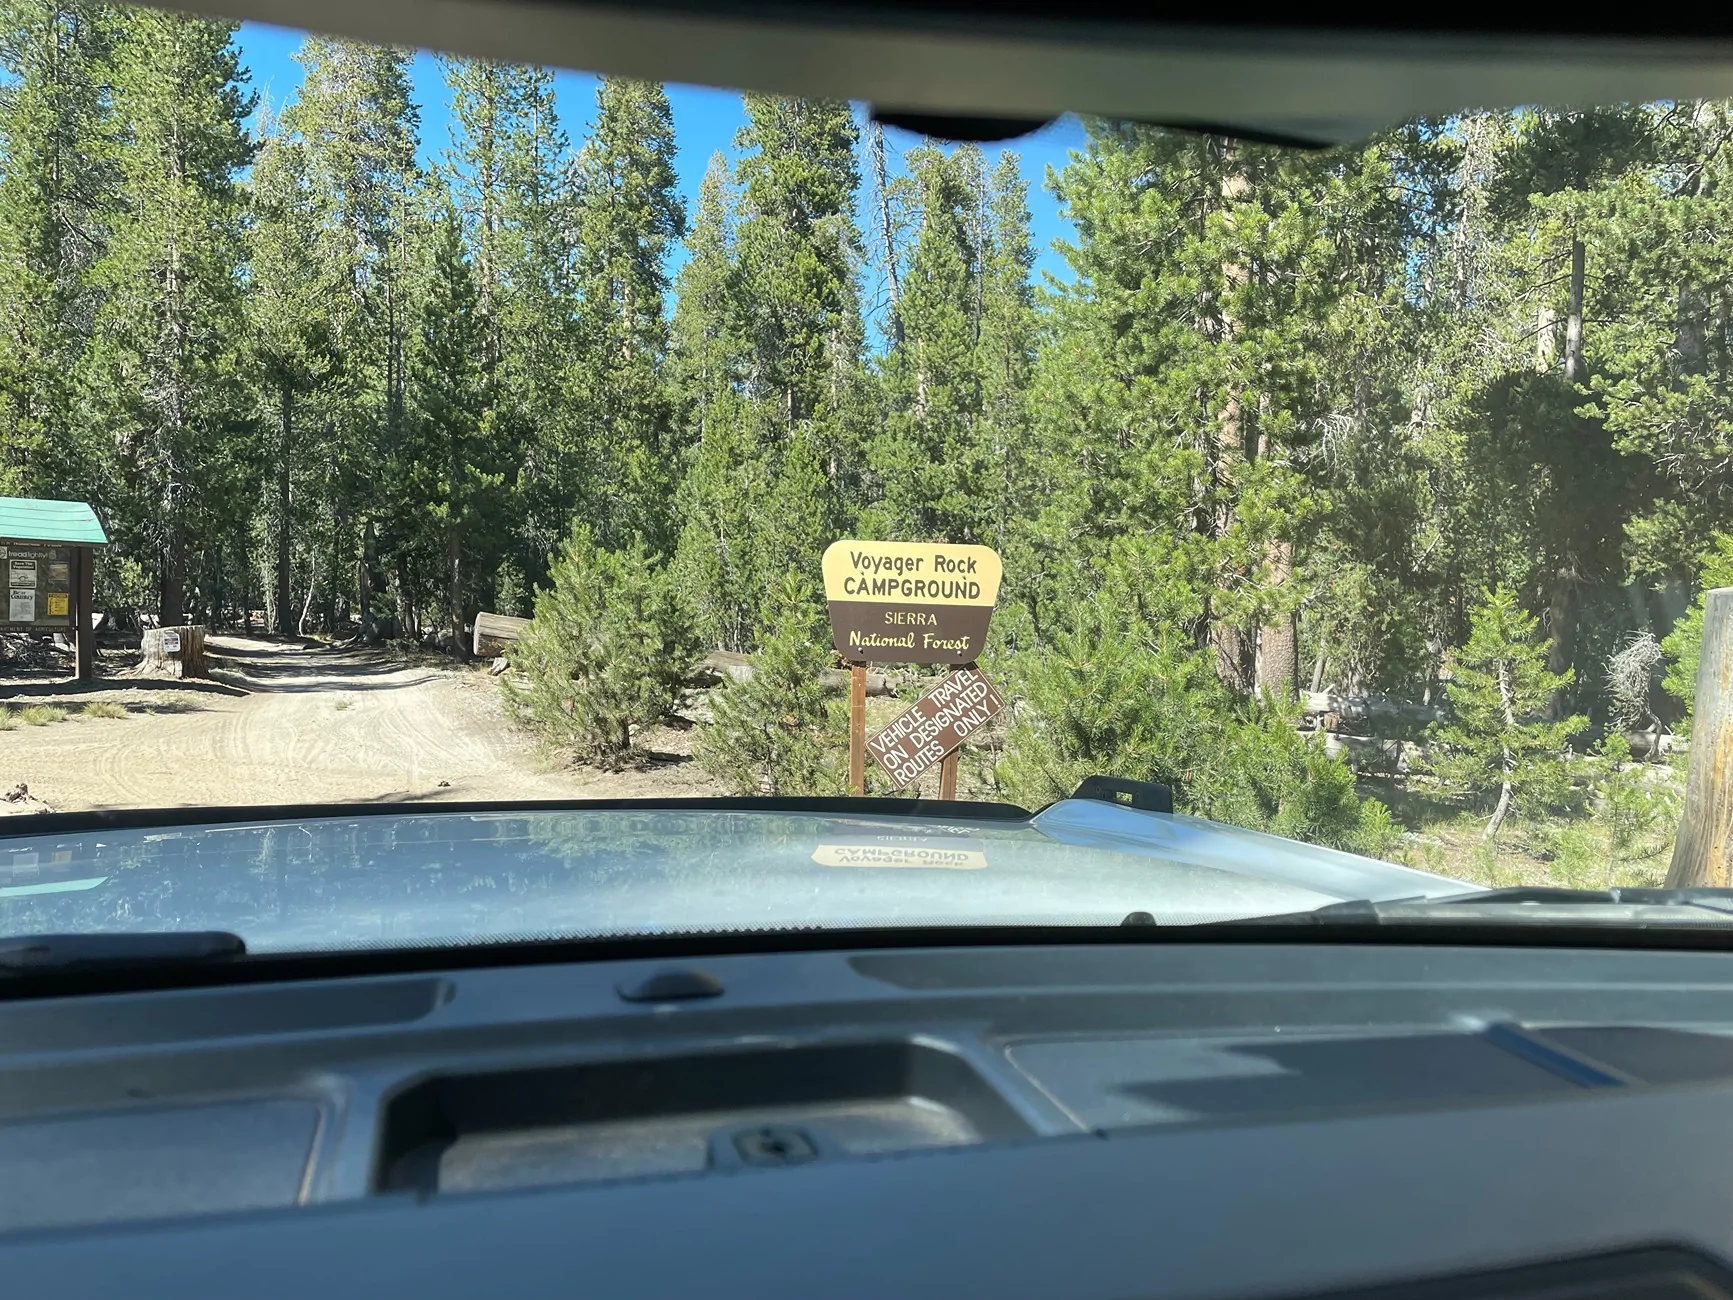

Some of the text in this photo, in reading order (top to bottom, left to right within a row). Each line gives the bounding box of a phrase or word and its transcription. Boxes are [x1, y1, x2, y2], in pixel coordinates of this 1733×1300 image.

[850, 551, 977, 576] Voyager Rock
[844, 576, 981, 600] CAMPGROUND
[884, 611, 938, 626] SIERRA
[850, 630, 971, 650] National Forest
[870, 668, 979, 753] VEHICLE TRAVEL
[883, 681, 988, 769] ON DESIGNATED
[894, 740, 944, 786] ROUTES
